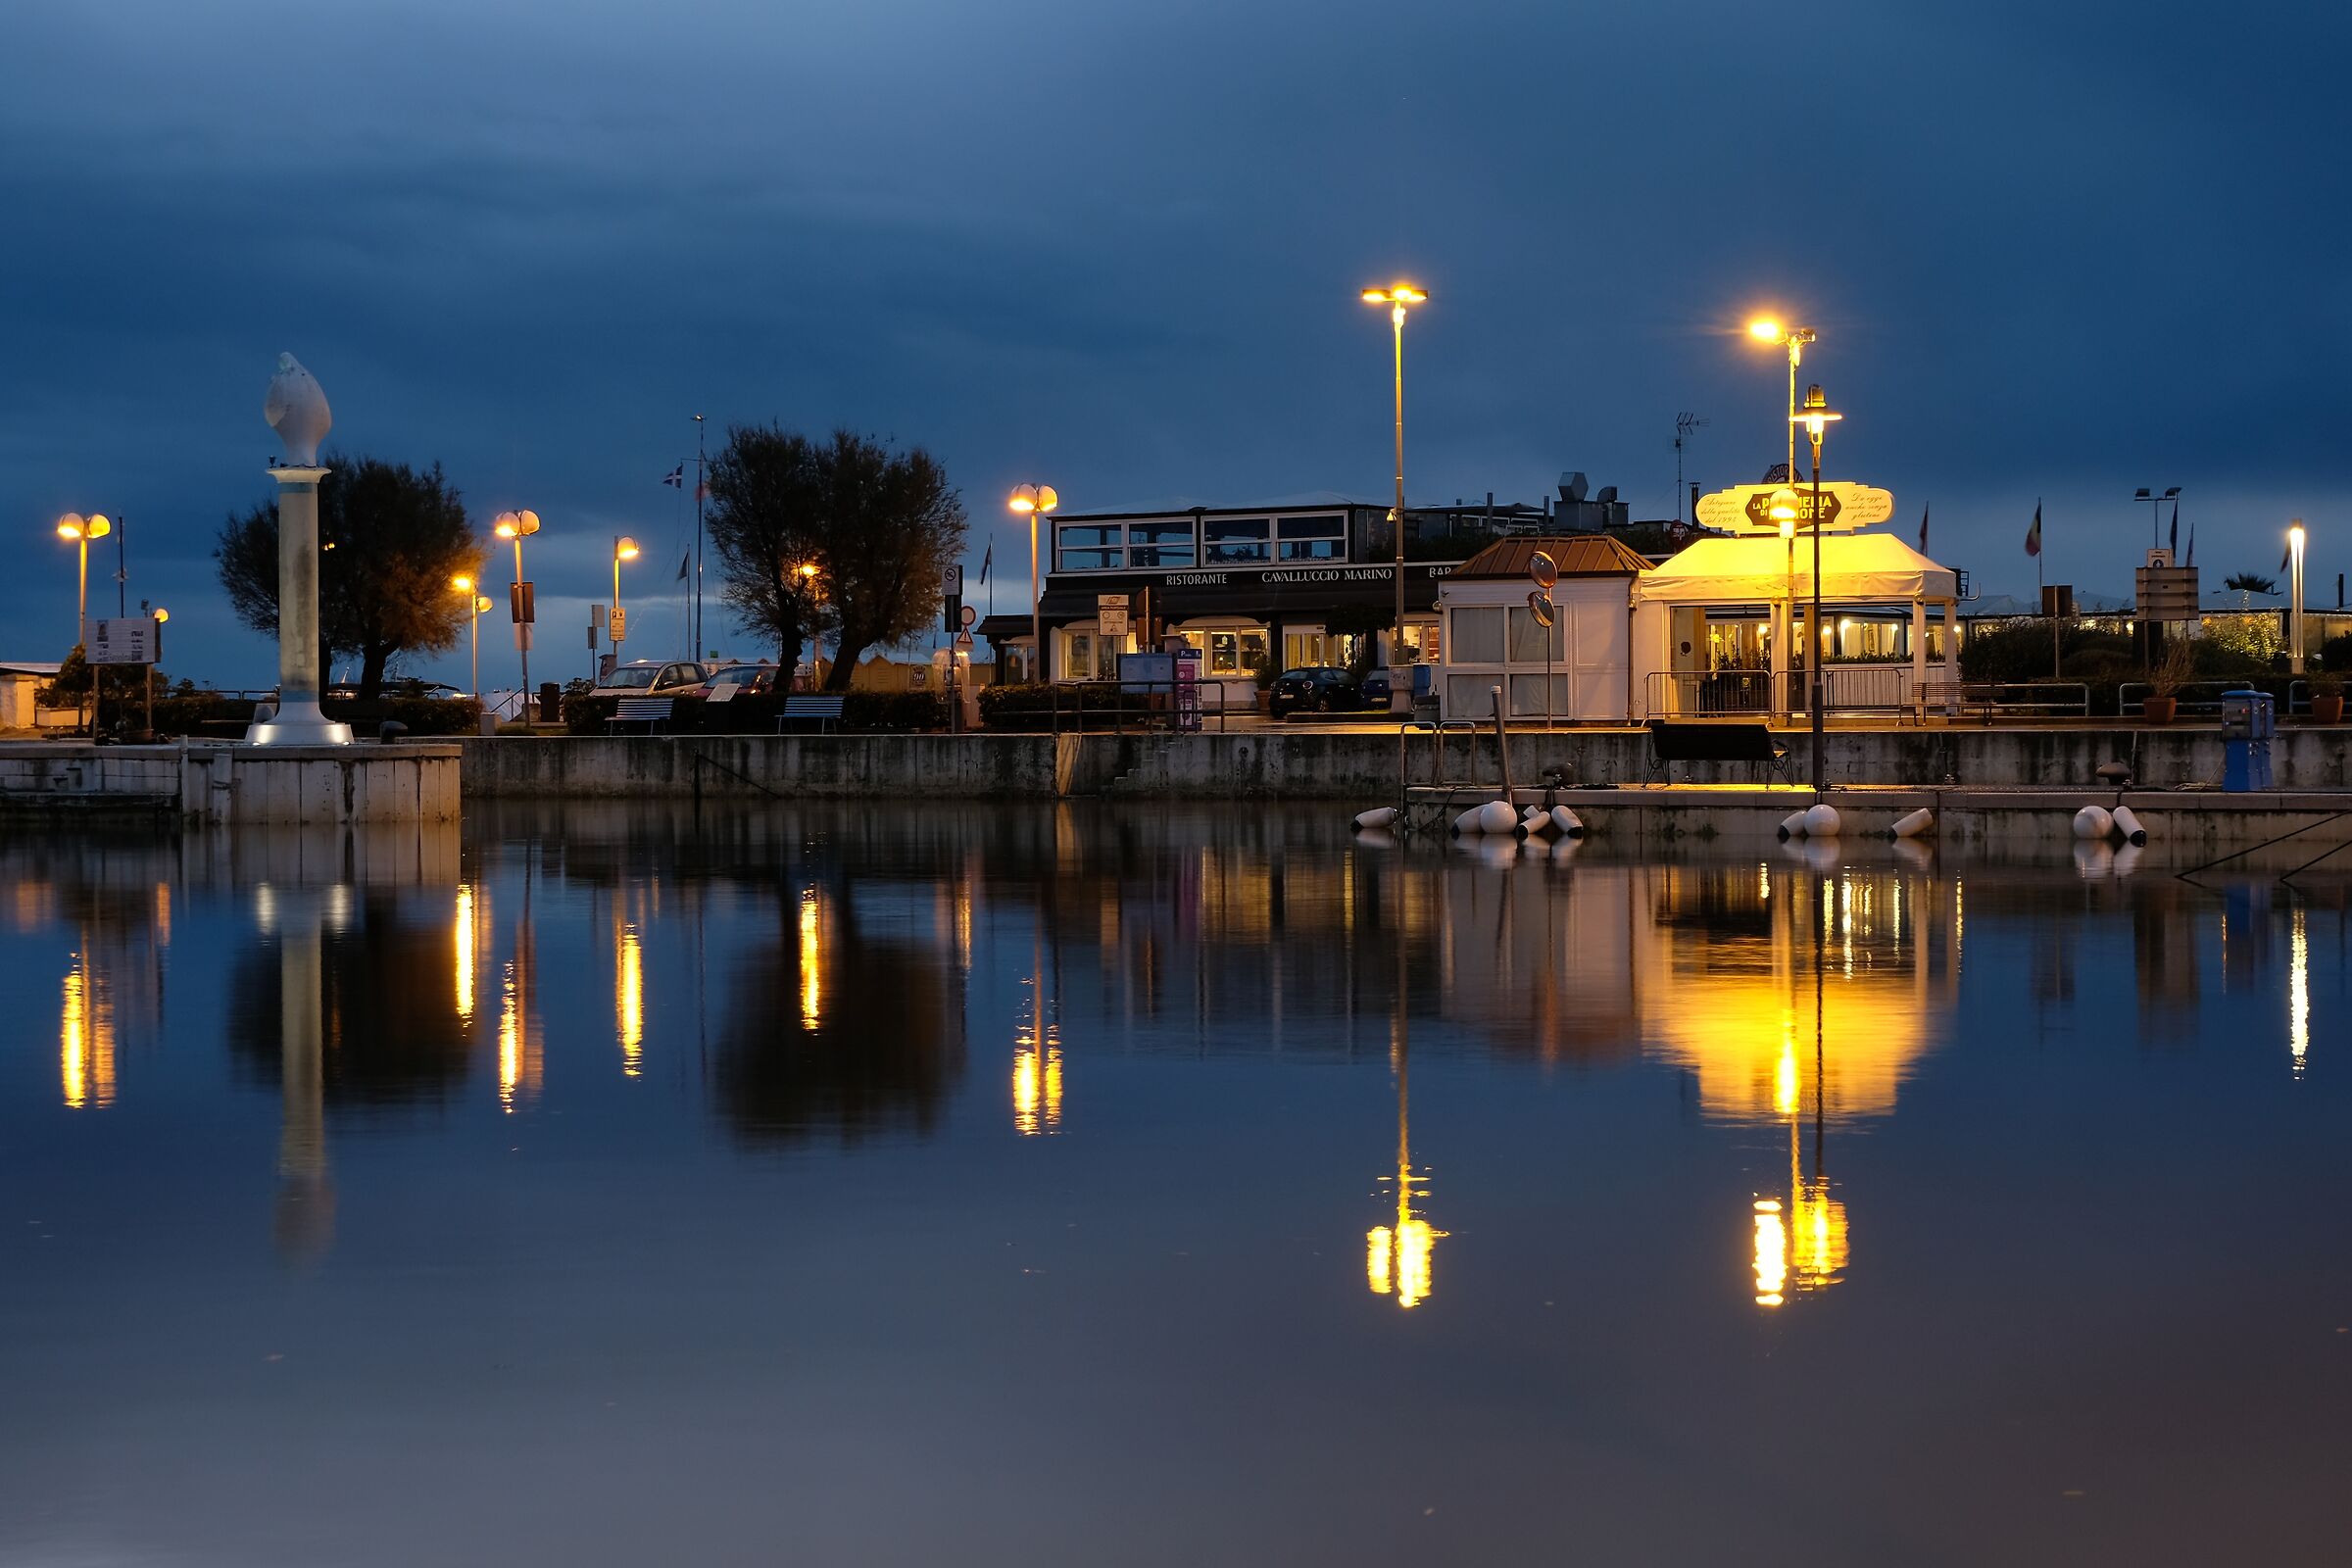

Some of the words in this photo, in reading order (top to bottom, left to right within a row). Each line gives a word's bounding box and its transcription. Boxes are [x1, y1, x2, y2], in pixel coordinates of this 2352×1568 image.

[1166, 573, 1227, 586] RISTORANTE
[1261, 570, 1340, 583] CAVALLUCCIO
[1344, 568, 1393, 581] MARINO
